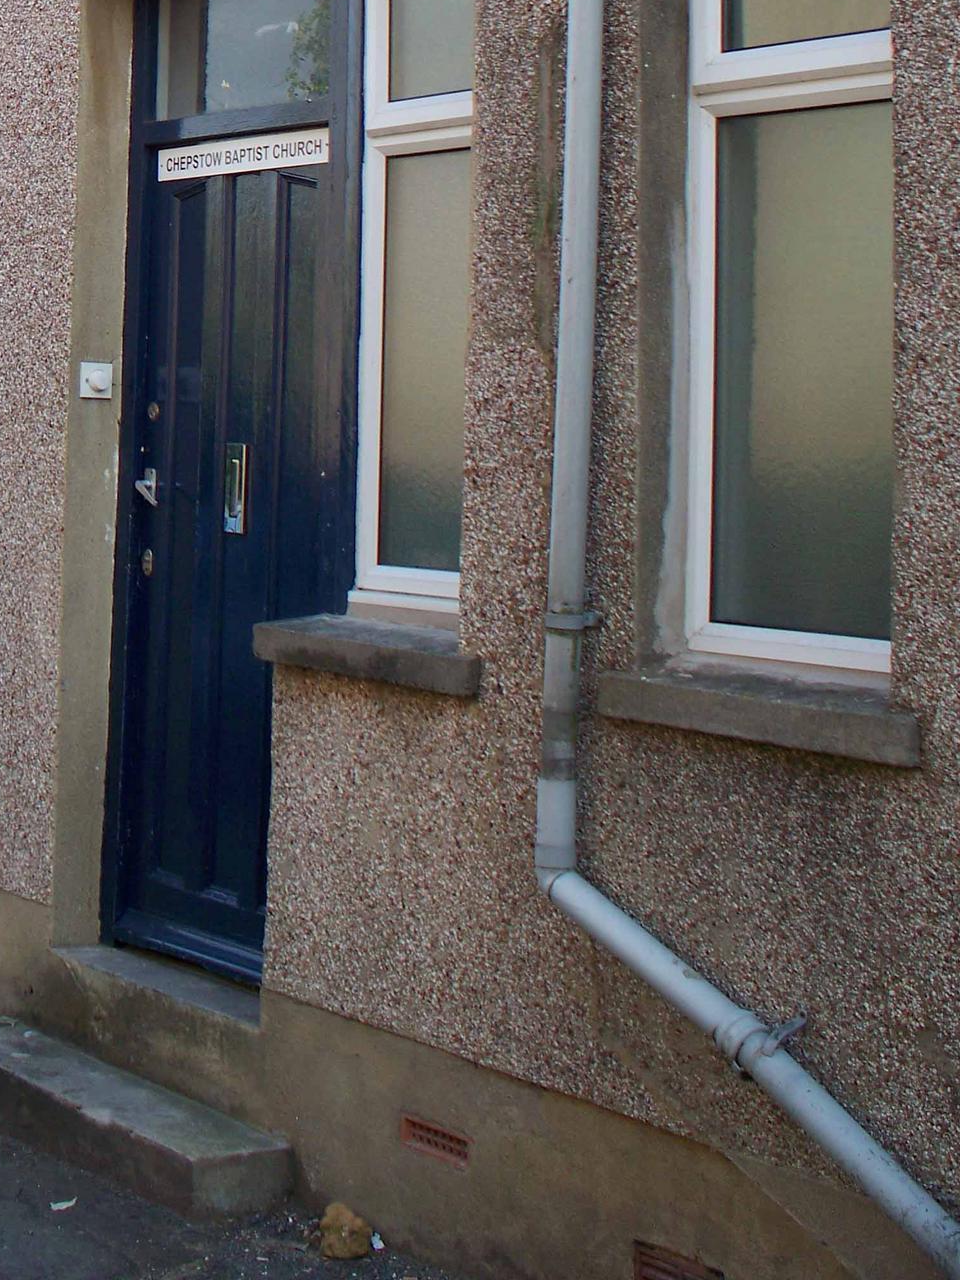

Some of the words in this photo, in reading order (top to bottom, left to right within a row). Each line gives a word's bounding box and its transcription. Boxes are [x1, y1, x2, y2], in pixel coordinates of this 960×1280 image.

[166, 151, 222, 172] CHEPSTOW
[225, 145, 270, 165] BAPTIST
[272, 139, 322, 159] CHURCH
